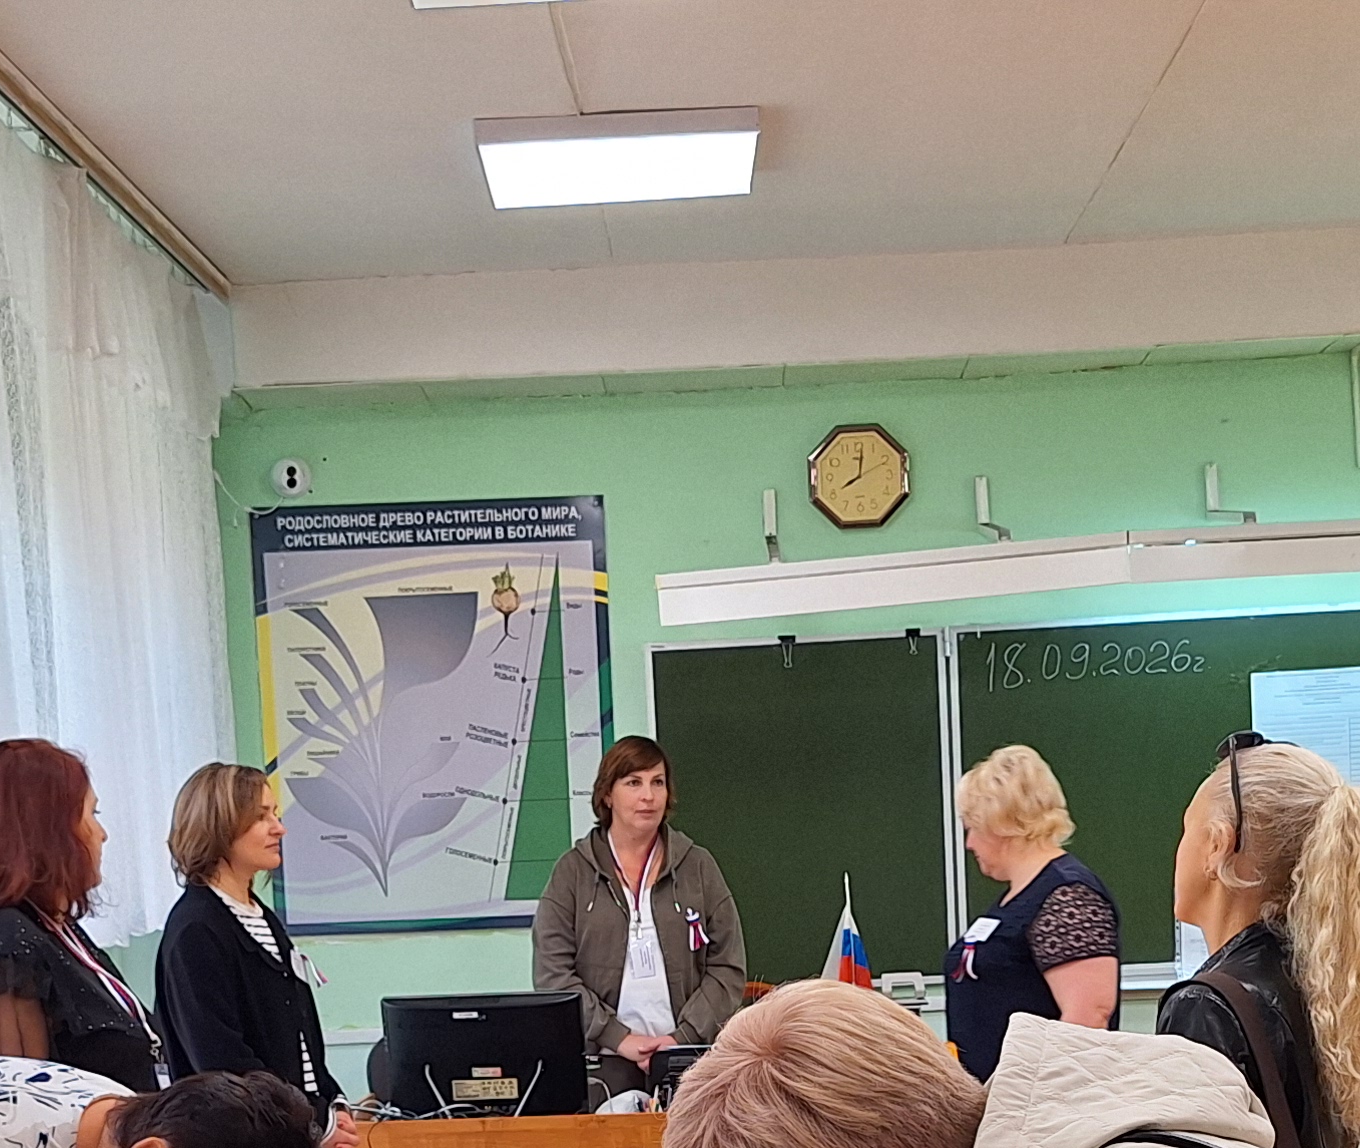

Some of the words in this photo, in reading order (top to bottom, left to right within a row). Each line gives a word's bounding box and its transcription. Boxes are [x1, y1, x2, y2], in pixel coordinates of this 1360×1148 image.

[276, 514, 376, 531] РОДОСЛОВНОЕ
[379, 511, 423, 529] ДРЕВО
[426, 507, 539, 525] РАСТИТЕЛЬНОГО
[541, 505, 582, 522] МИРА,
[284, 528, 414, 548] СИСТЕМАТИЧЕСКИЕ
[416, 525, 493, 543] КАТЕГОРИИ
[495, 526, 504, 540] В
[507, 523, 577, 540] БОТАНИКЕ
